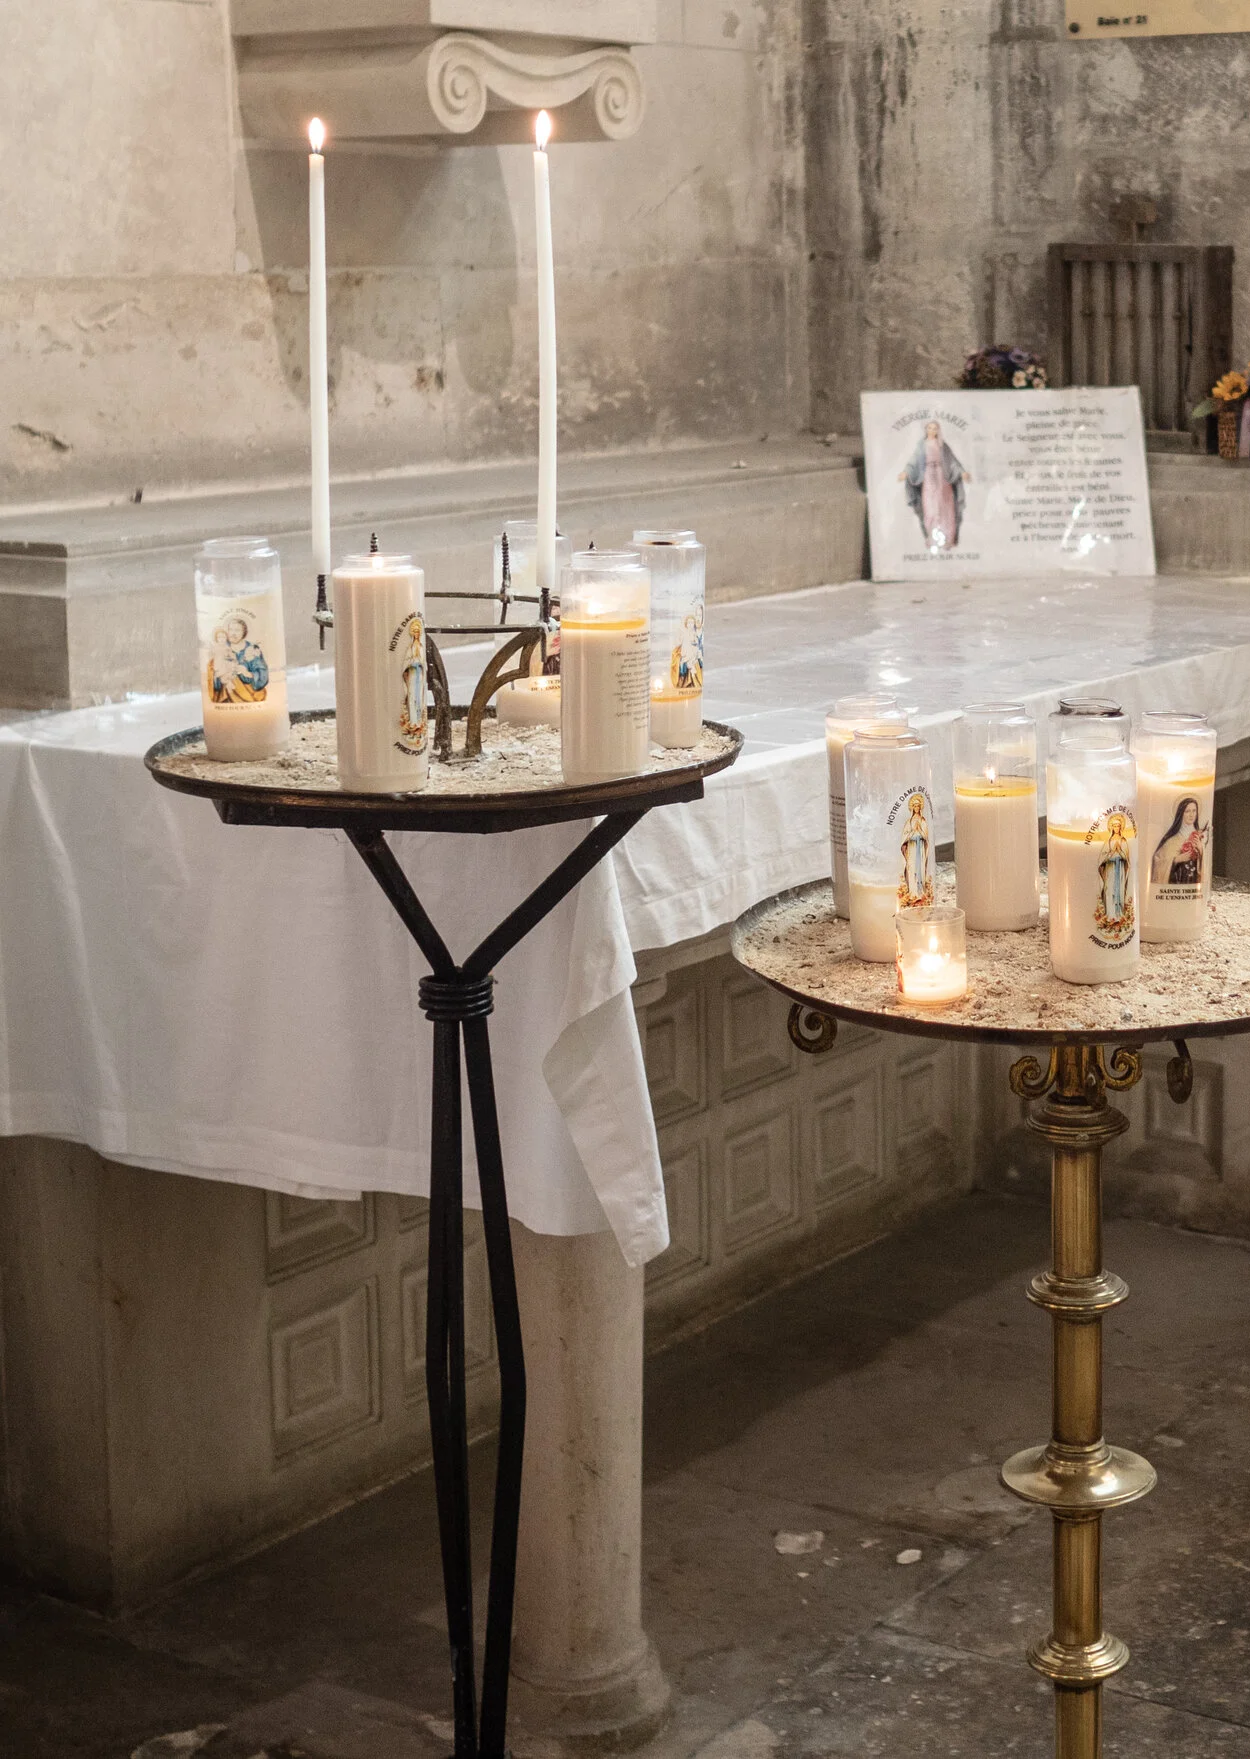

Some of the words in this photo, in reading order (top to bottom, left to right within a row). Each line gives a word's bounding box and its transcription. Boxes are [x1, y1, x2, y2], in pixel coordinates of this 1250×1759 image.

[892, 408, 930, 432] VIERGE
[934, 409, 967, 432] MARIE
[388, 627, 404, 652] NOTRE
[401, 611, 417, 628] DAME
[886, 801, 902, 826] NOTRE
[899, 786, 917, 802] DAME
[917, 785, 926, 793] DE
[1084, 820, 1100, 845] NOTRE
[1118, 804, 1127, 813] DE
[1088, 934, 1108, 949] PRIEZ
[1107, 942, 1125, 950] POUR
